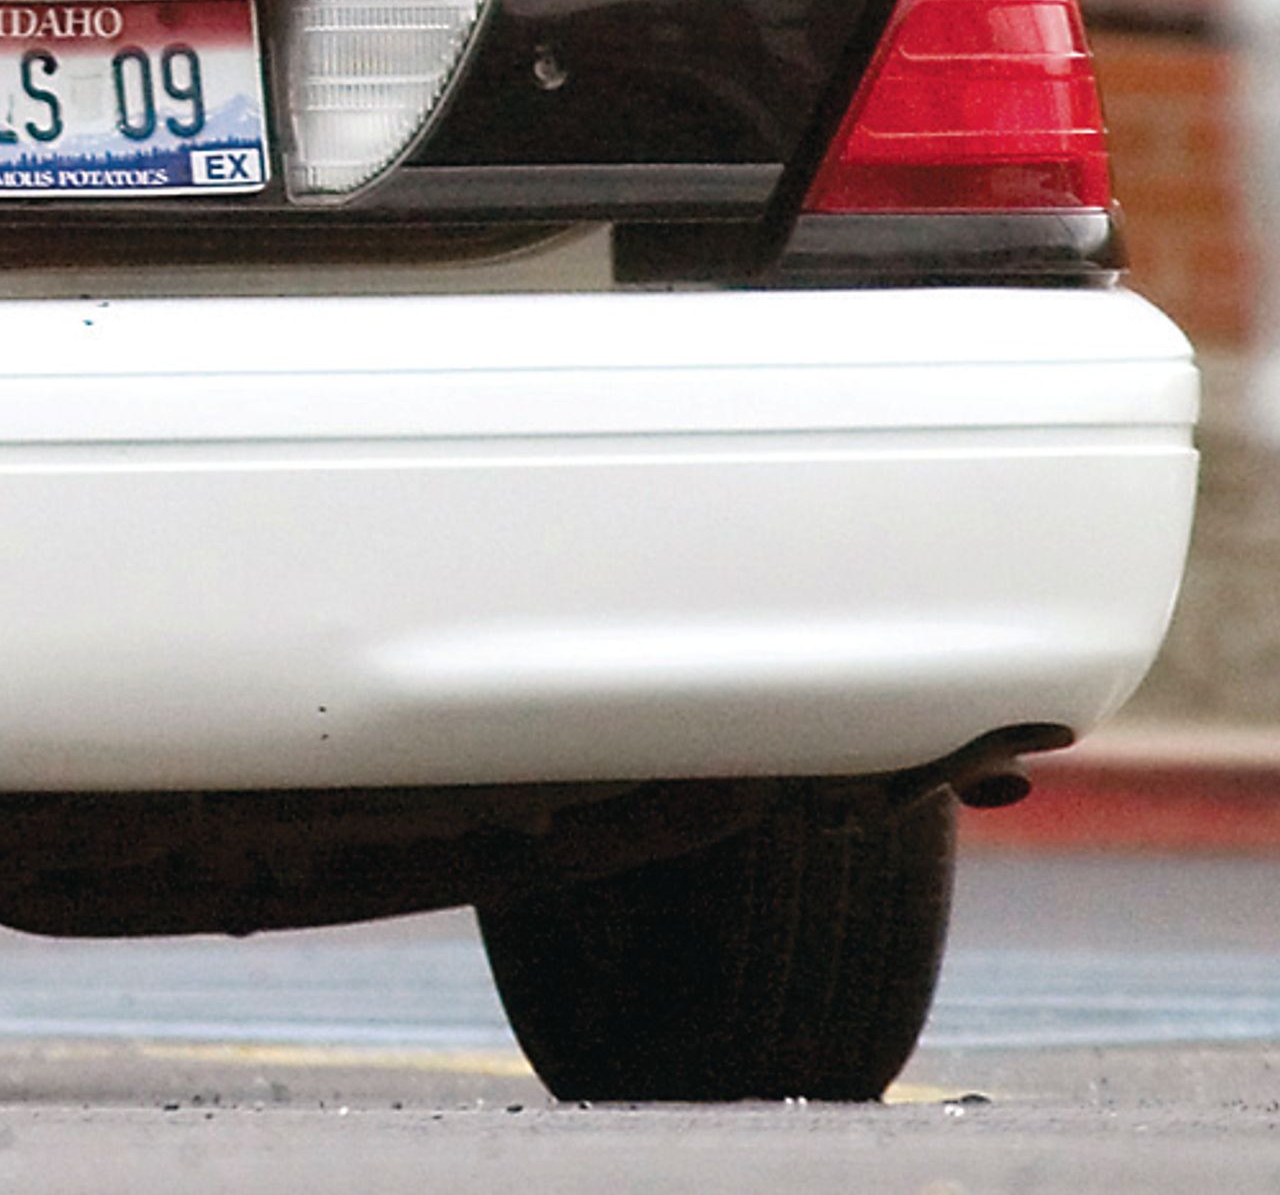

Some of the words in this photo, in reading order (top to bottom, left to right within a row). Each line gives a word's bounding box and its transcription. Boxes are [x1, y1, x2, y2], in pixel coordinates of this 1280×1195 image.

[112, 43, 207, 141] 09
[58, 168, 170, 187] POTATOES
[205, 153, 251, 180] EX
